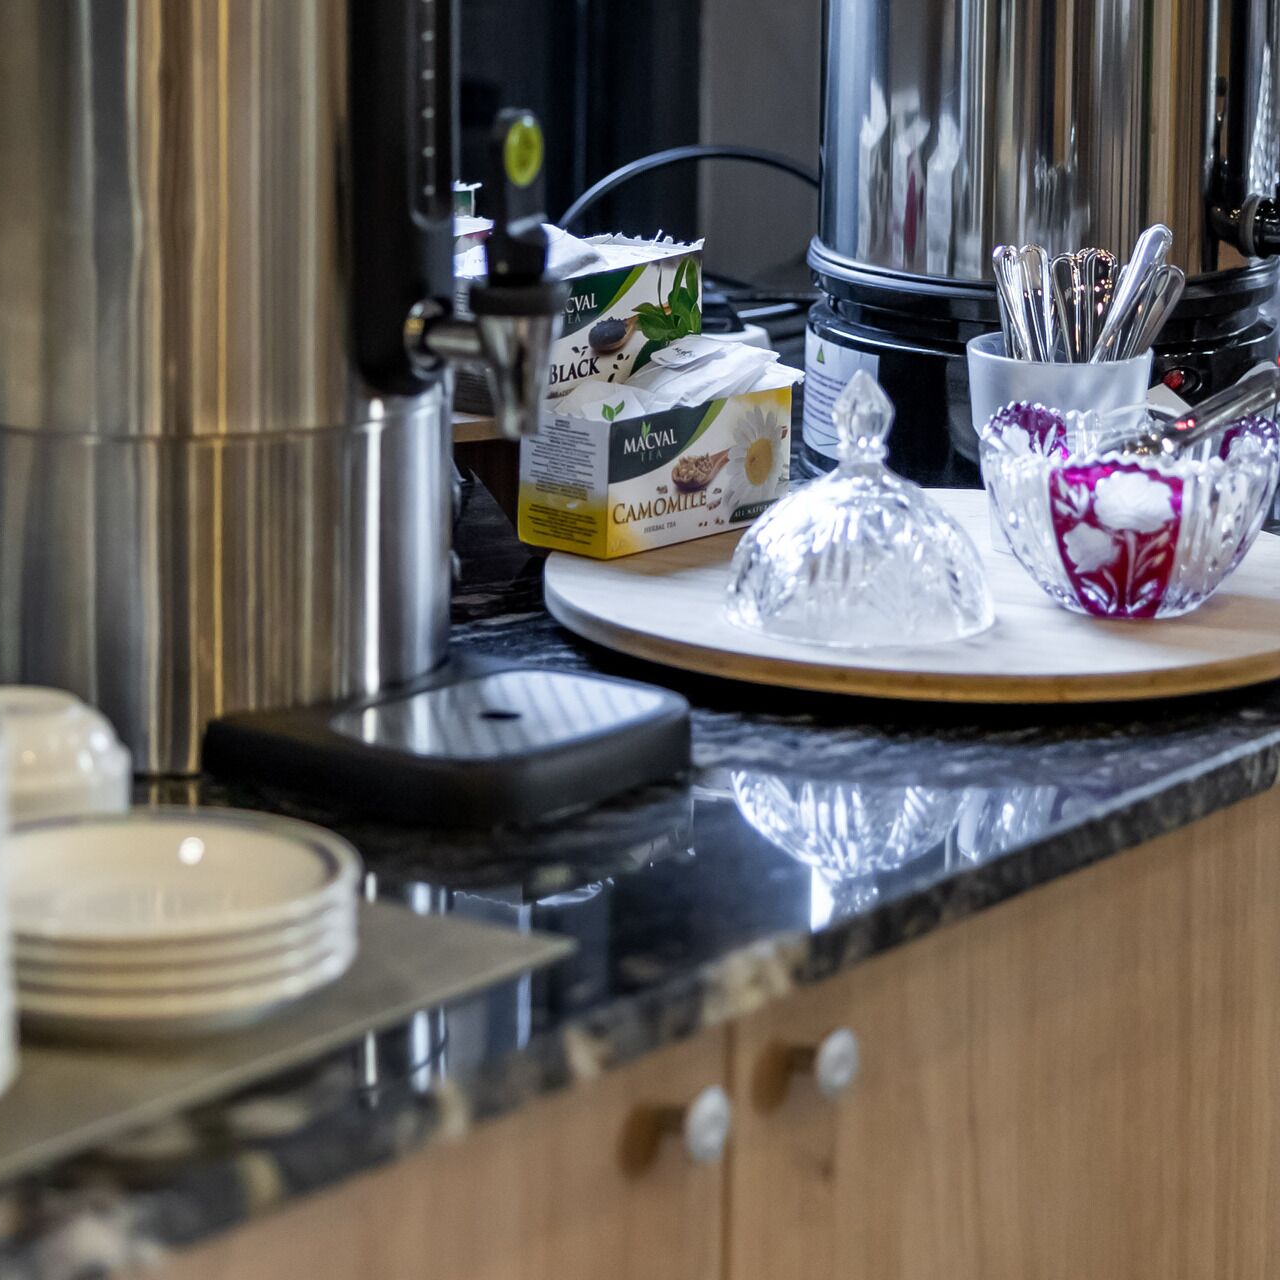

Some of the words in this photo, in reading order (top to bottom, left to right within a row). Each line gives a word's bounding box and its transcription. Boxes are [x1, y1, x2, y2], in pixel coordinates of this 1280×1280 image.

[564, 293, 598, 313] CVAL
[549, 357, 601, 384] BLACK
[623, 429, 678, 455] MACVAL
[640, 446, 663, 463] TEA
[612, 491, 707, 525] CAMOMILE
[747, 503, 770, 514] NATUR
[643, 523, 665, 534] HERBAL
[667, 520, 677, 529] TEA
